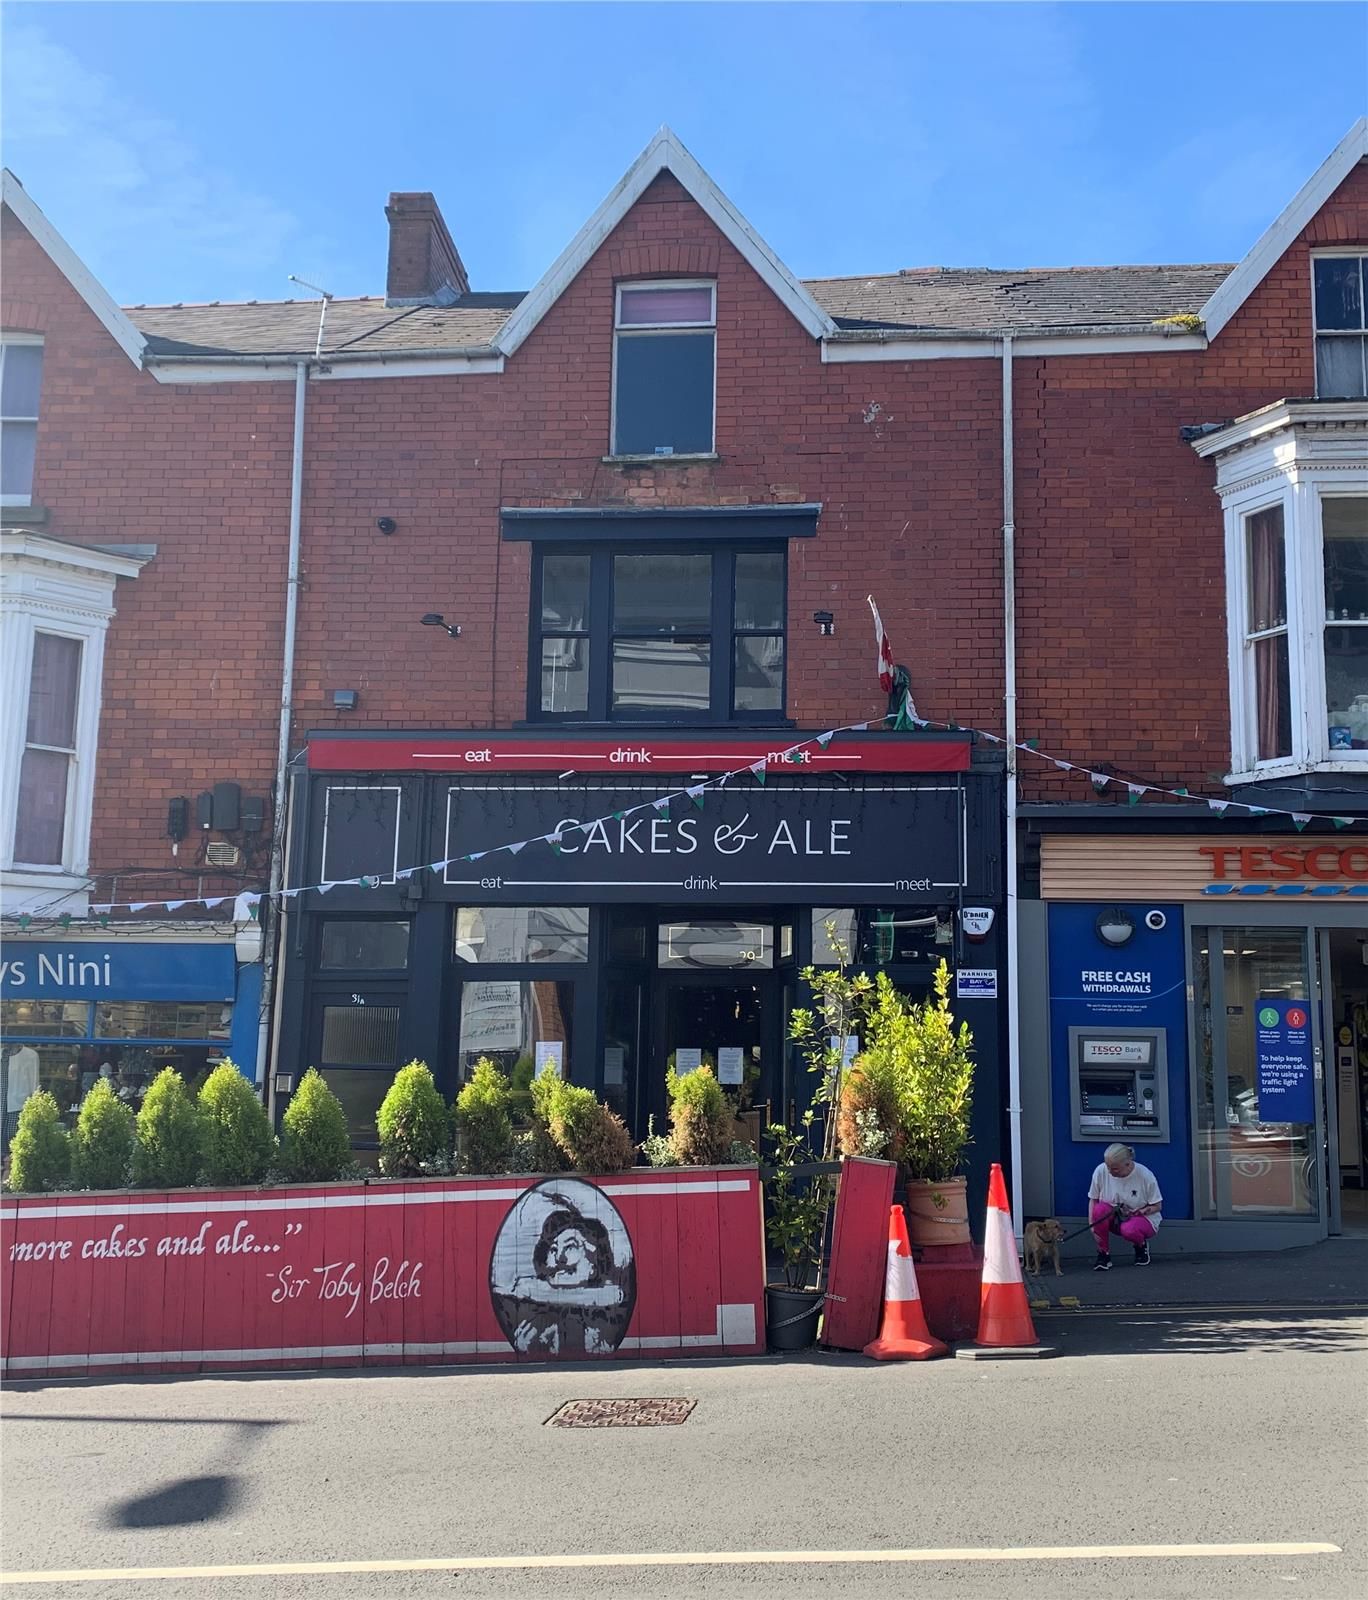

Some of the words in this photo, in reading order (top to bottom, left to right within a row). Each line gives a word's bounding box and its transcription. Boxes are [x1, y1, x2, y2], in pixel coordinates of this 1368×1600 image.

[464, 749, 491, 762] eat
[609, 748, 651, 763] drink
[552, 818, 698, 854] CAKES
[714, 813, 758, 854] &
[768, 820, 851, 855] ALE
[1200, 845, 1368, 880] TESCO
[480, 876, 502, 888] eat
[683, 875, 718, 890] drink
[895, 878, 931, 891] meet
[38, 953, 111, 986] Nini
[1081, 971, 1113, 982] FREE
[1115, 972, 1151, 983] CASH
[1082, 984, 1152, 994] WITHDRAWALS
[1091, 1045, 1122, 1053] TESCO
[1285, 1055, 1303, 1063] keep
[1280, 1071, 1298, 1079] using
[1283, 1079, 1298, 1087] light
[9, 1240, 73, 1261] more
[81, 1223, 149, 1259] cakes
[156, 1220, 213, 1256] and
[313, 1261, 362, 1319] Toby
[369, 1256, 423, 1304] Belch
